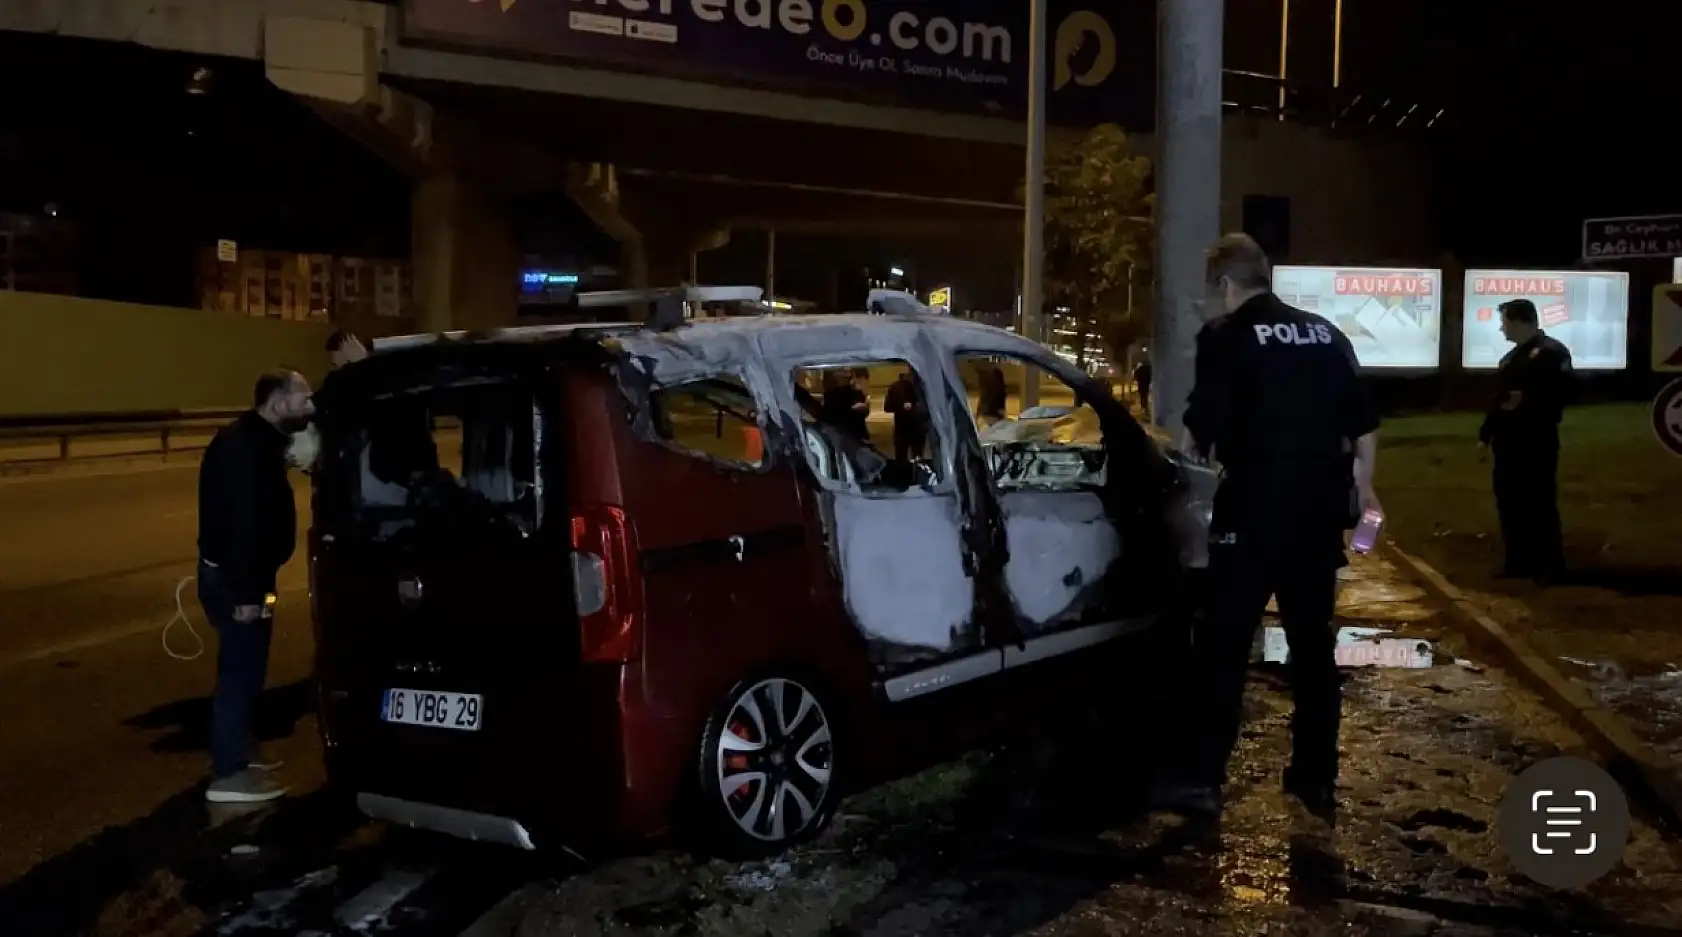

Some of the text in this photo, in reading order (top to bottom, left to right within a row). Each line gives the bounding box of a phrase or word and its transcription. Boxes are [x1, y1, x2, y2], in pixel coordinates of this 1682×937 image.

[1335, 278, 1431, 294] BAUHAUS
[1474, 278, 1566, 294] BAUHAUS
[390, 690, 478, 727] 16 YBG 29
